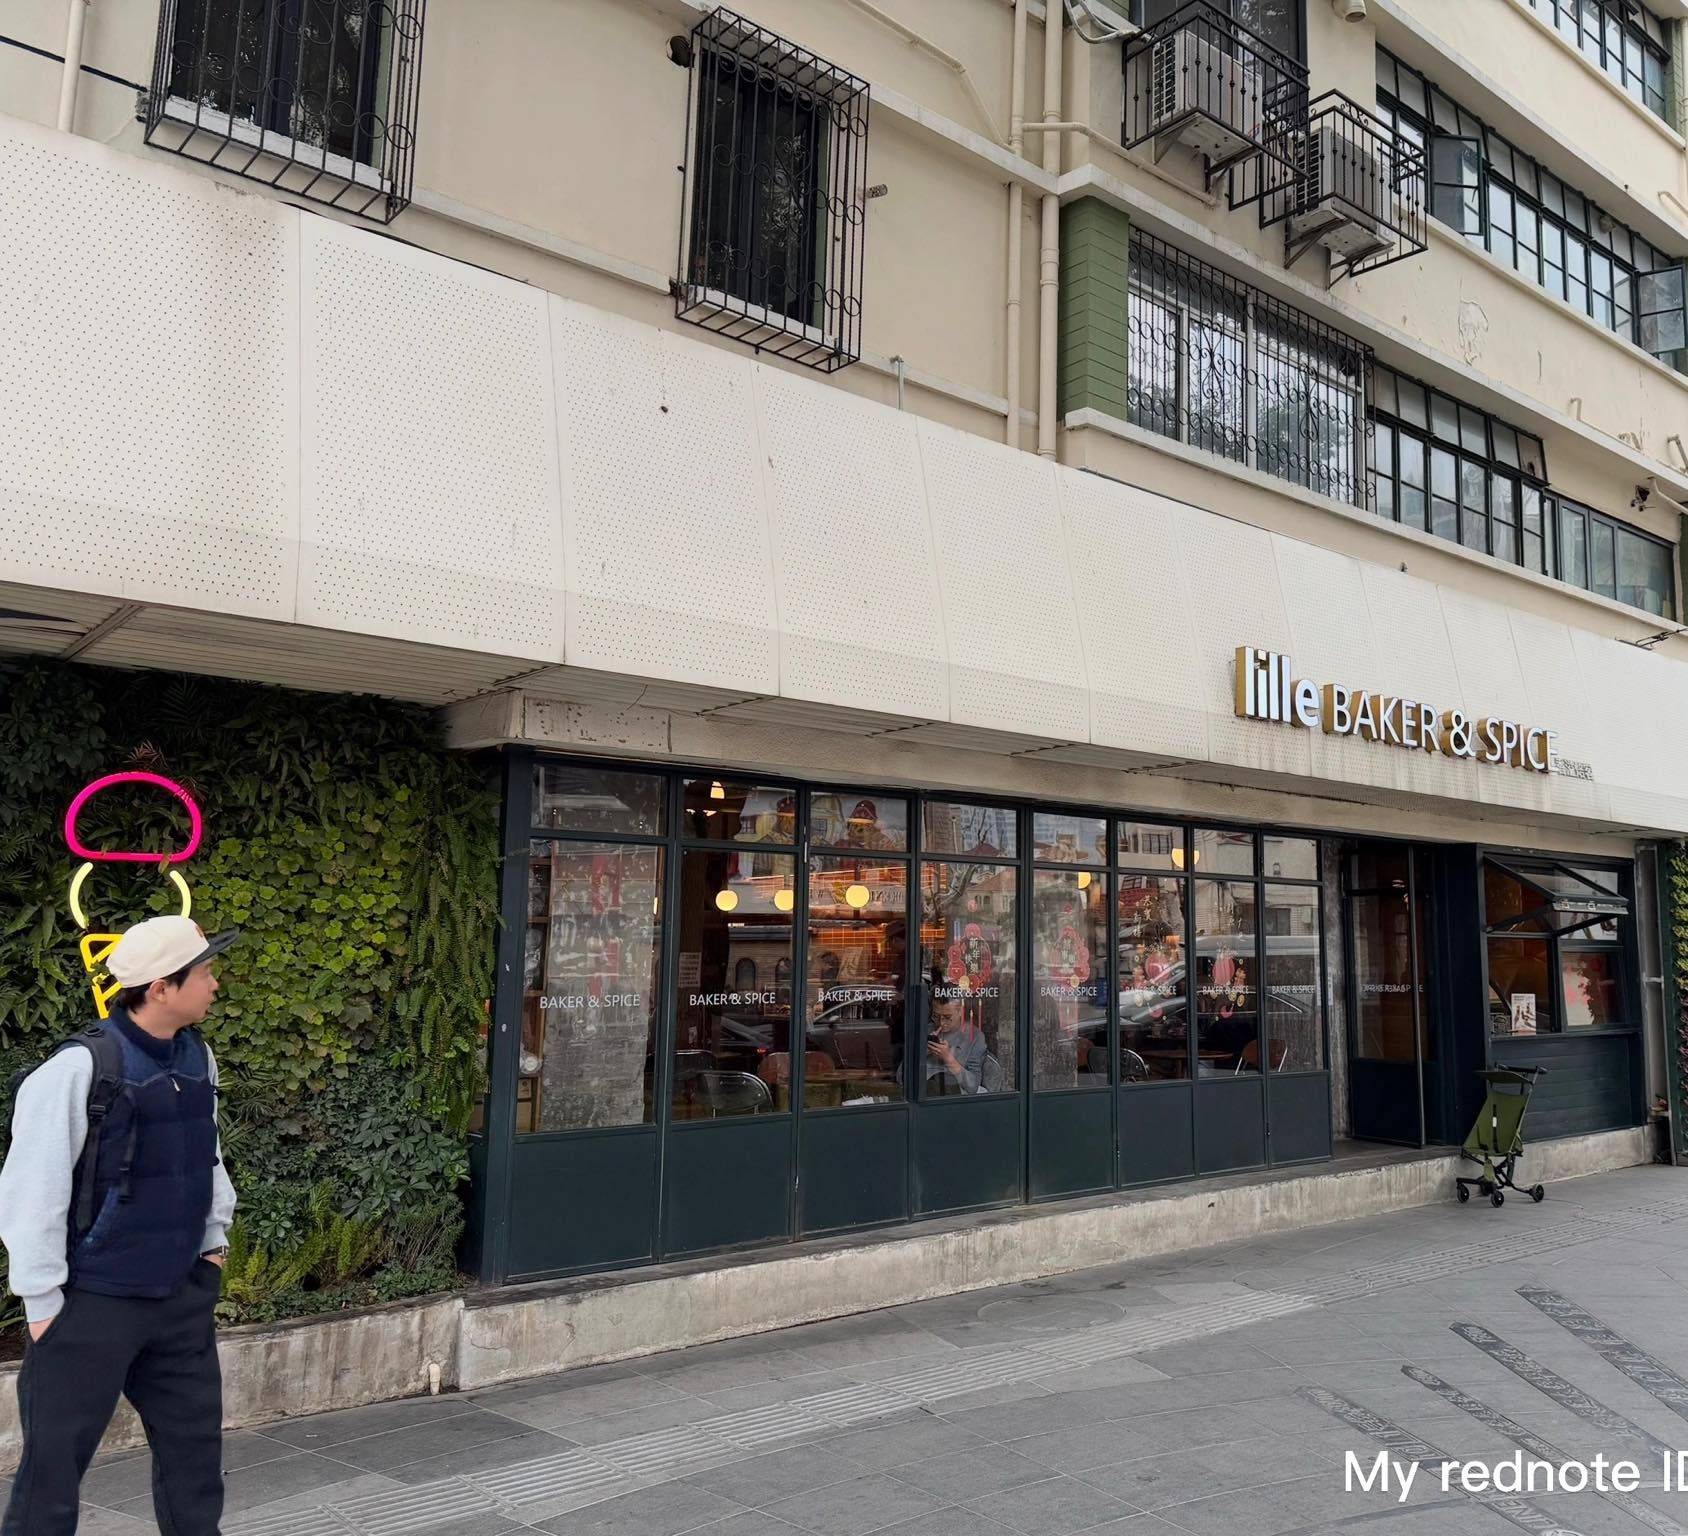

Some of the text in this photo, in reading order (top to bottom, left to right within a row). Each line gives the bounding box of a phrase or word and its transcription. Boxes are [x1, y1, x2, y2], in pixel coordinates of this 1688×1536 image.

[1236, 645, 1558, 773] lille BAKER & SPICE
[817, 990, 850, 1002] BAKER
[864, 989, 893, 1001] SPICE
[934, 986, 999, 998] BAKER & SPICE
[1040, 986, 1066, 997] BAKER
[1077, 986, 1098, 997] SPICE
[539, 993, 641, 1009] BAKER & SPICE
[688, 992, 776, 1006] BAKER & SPICE
